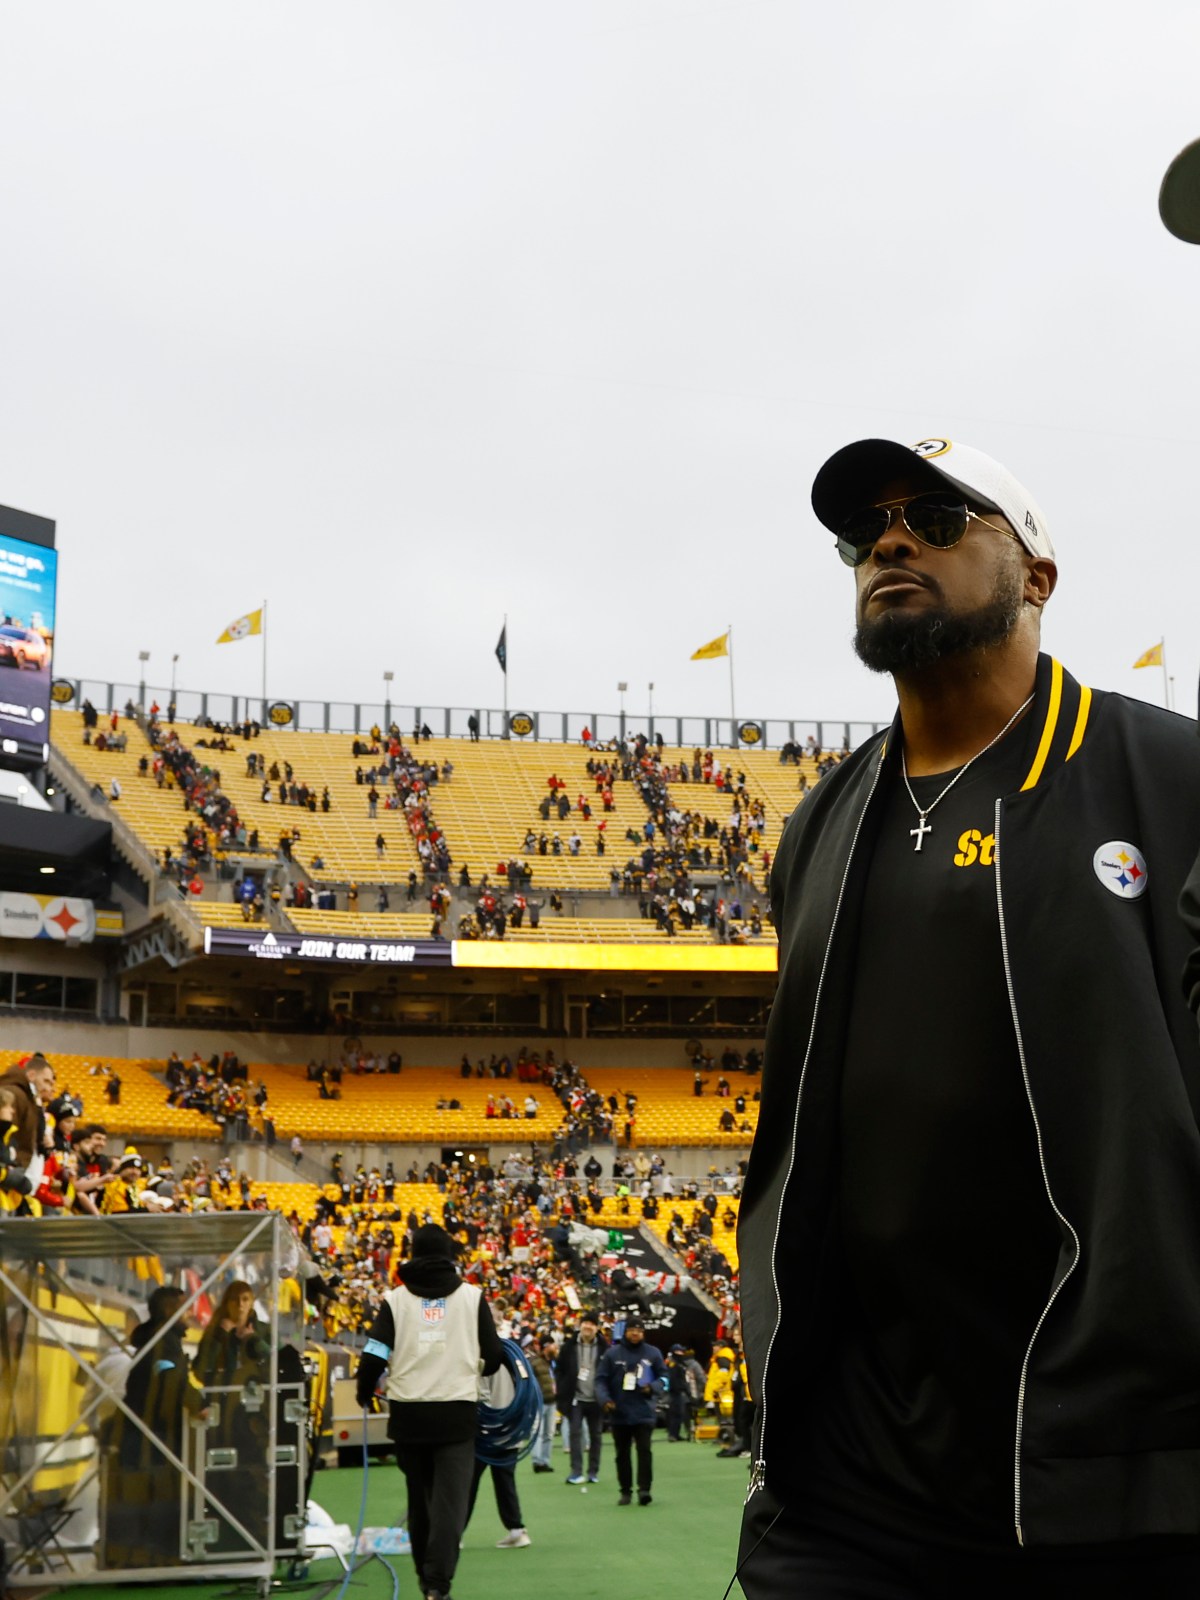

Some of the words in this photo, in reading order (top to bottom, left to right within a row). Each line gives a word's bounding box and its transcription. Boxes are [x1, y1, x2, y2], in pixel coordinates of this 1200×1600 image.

[953, 828, 996, 867] St
[1100, 860, 1122, 870] Steelers
[4, 908, 39, 920] Steelers
[298, 940, 335, 958] JOIN
[336, 942, 368, 961] OUR
[370, 944, 417, 962] TEAM!
[424, 1308, 444, 1321] NFL
